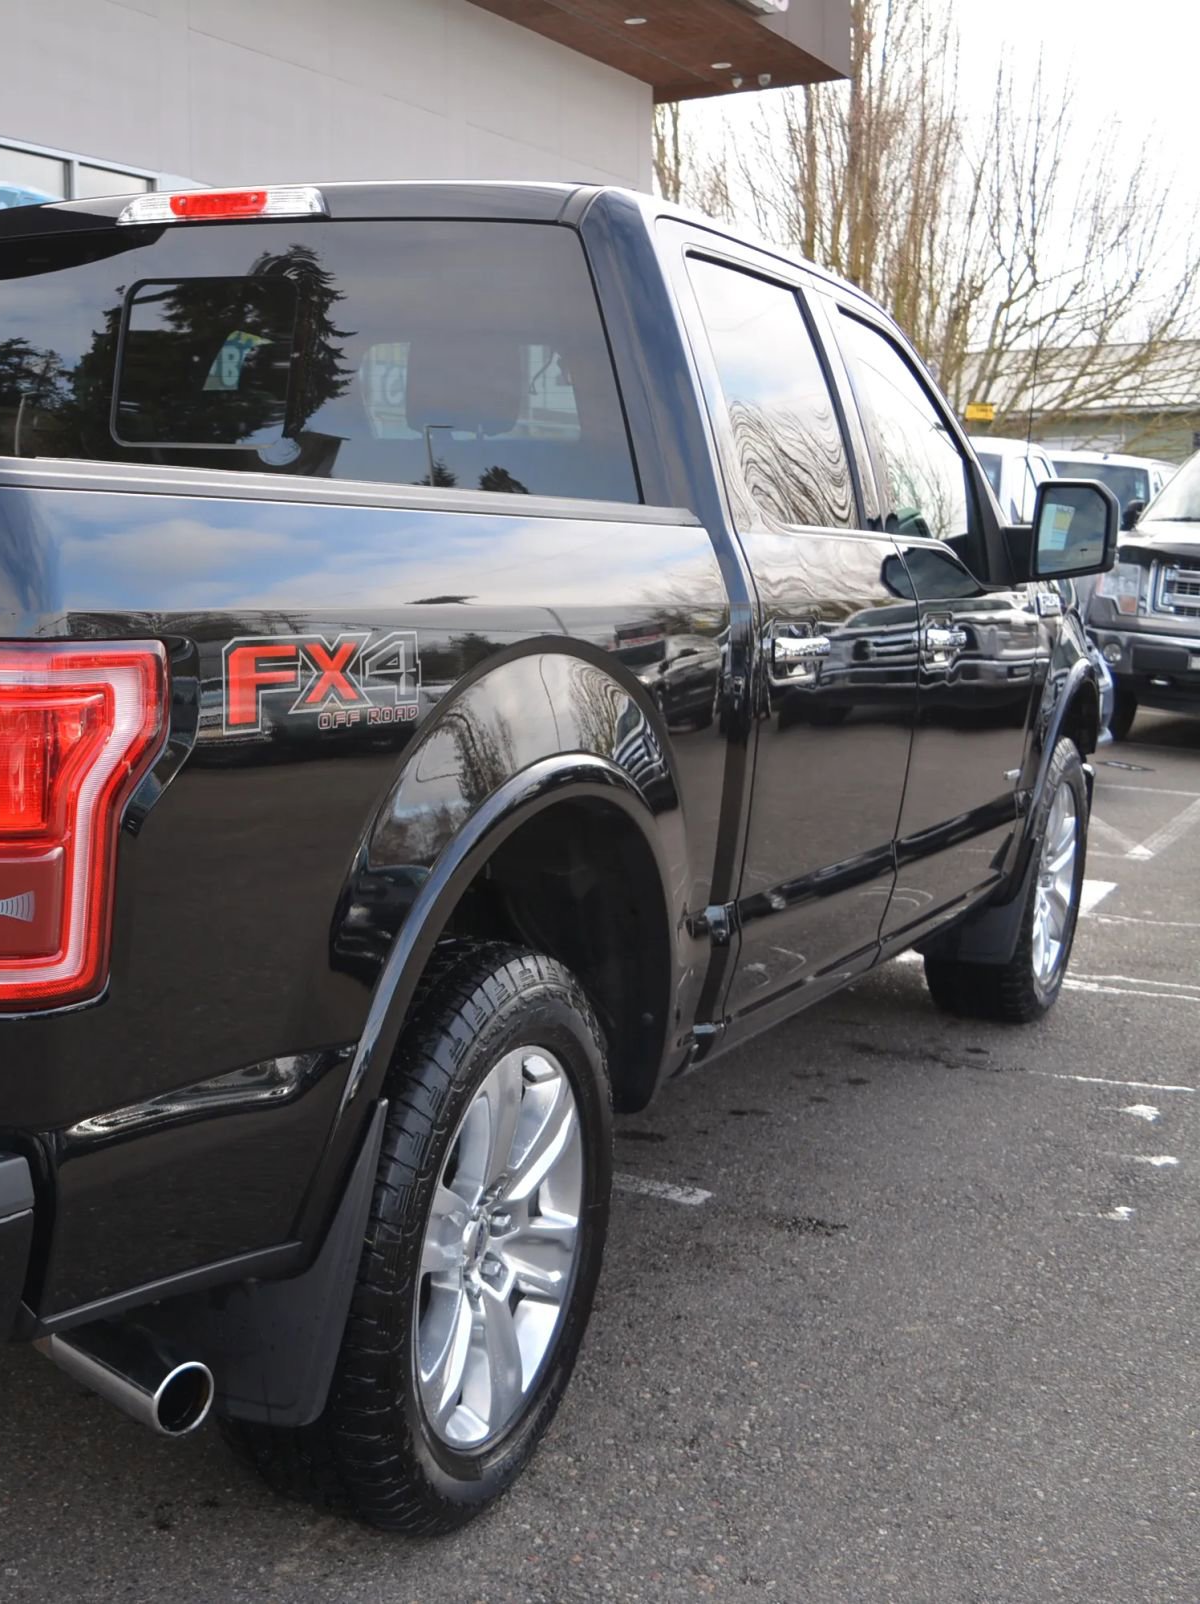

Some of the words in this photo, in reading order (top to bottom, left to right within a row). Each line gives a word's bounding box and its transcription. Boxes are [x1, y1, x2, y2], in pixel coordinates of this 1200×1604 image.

[222, 631, 421, 735] FX4
[318, 711, 361, 730] OFF
[367, 705, 420, 725] ROAD
